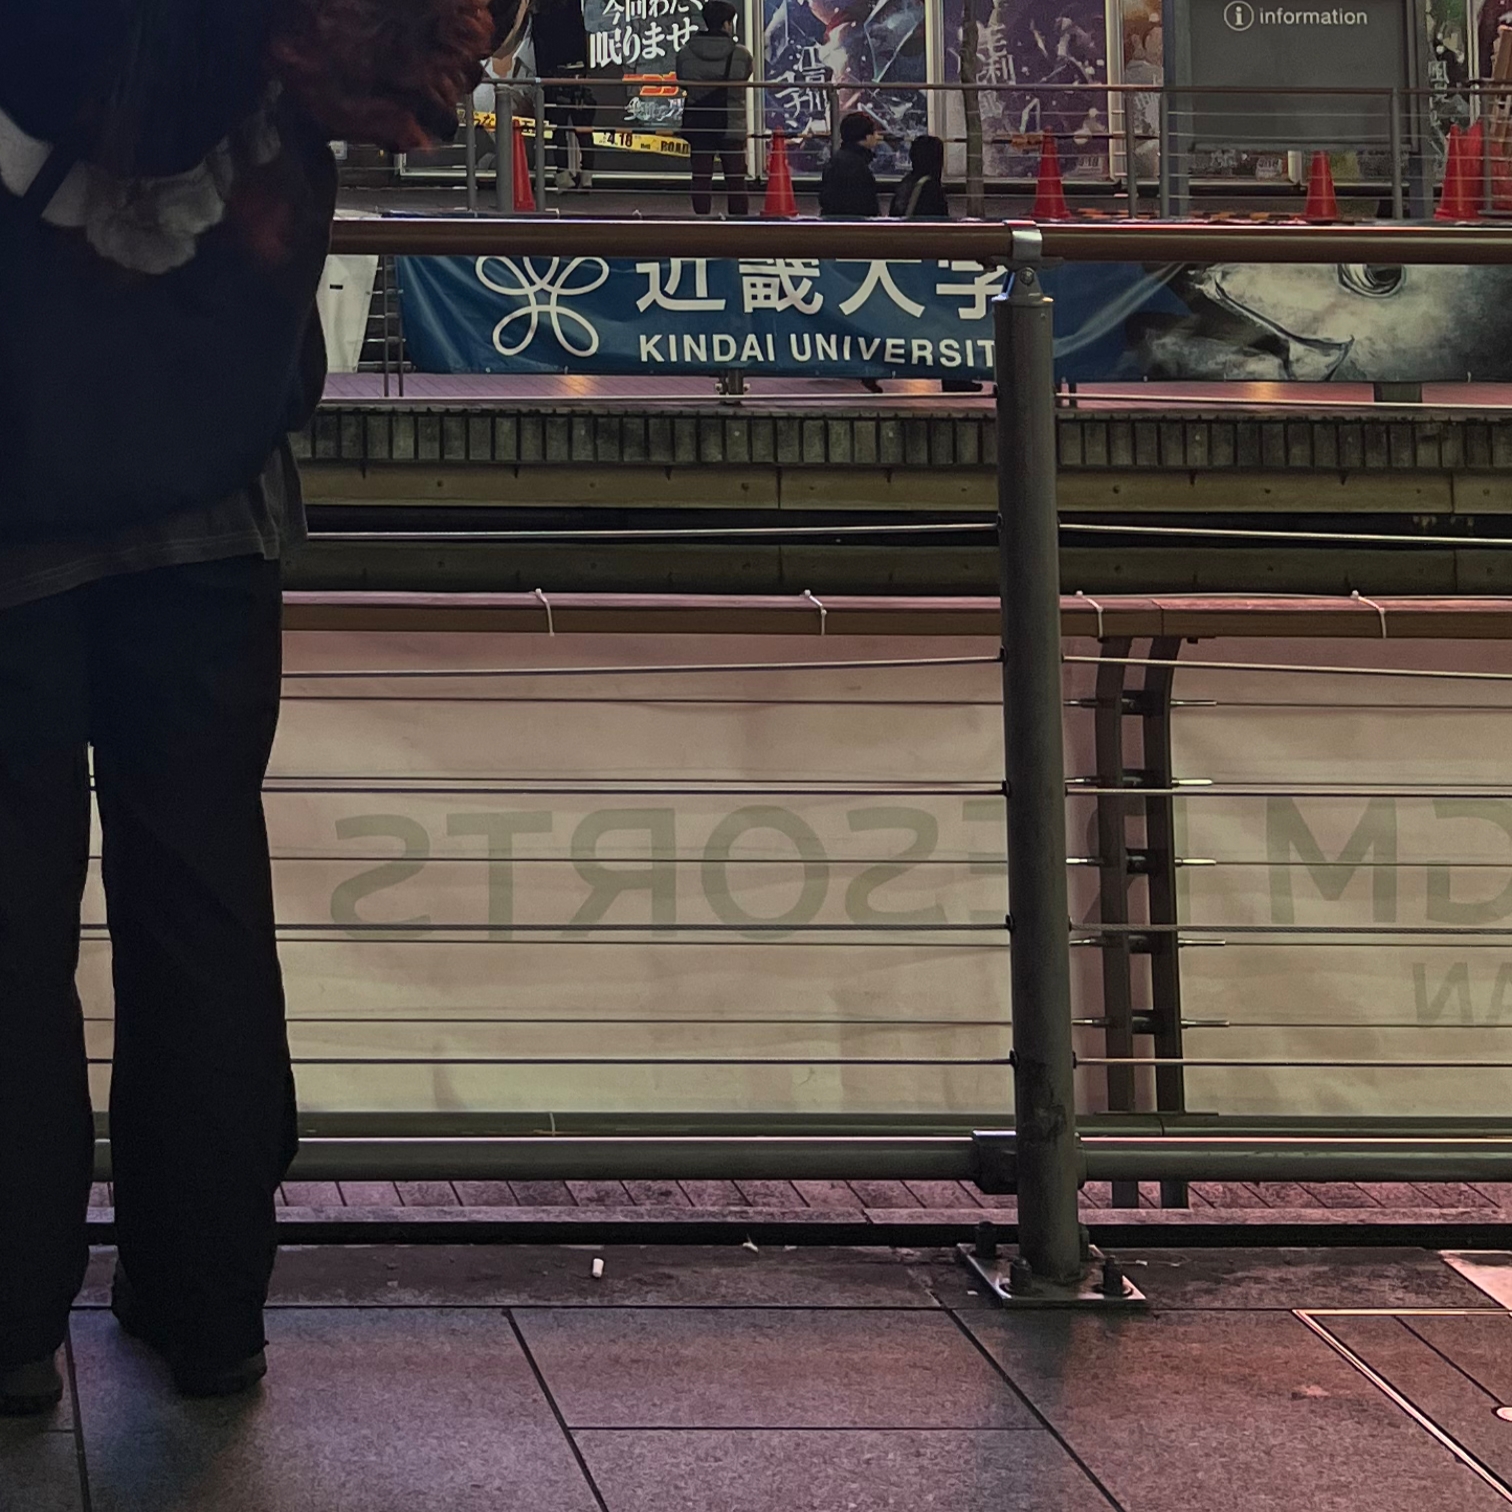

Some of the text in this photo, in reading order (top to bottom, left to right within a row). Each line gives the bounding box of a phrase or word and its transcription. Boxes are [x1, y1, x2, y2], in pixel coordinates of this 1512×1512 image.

[1259, 7, 1368, 25] information
[639, 332, 996, 368] KINDAI UNIVERSIT
